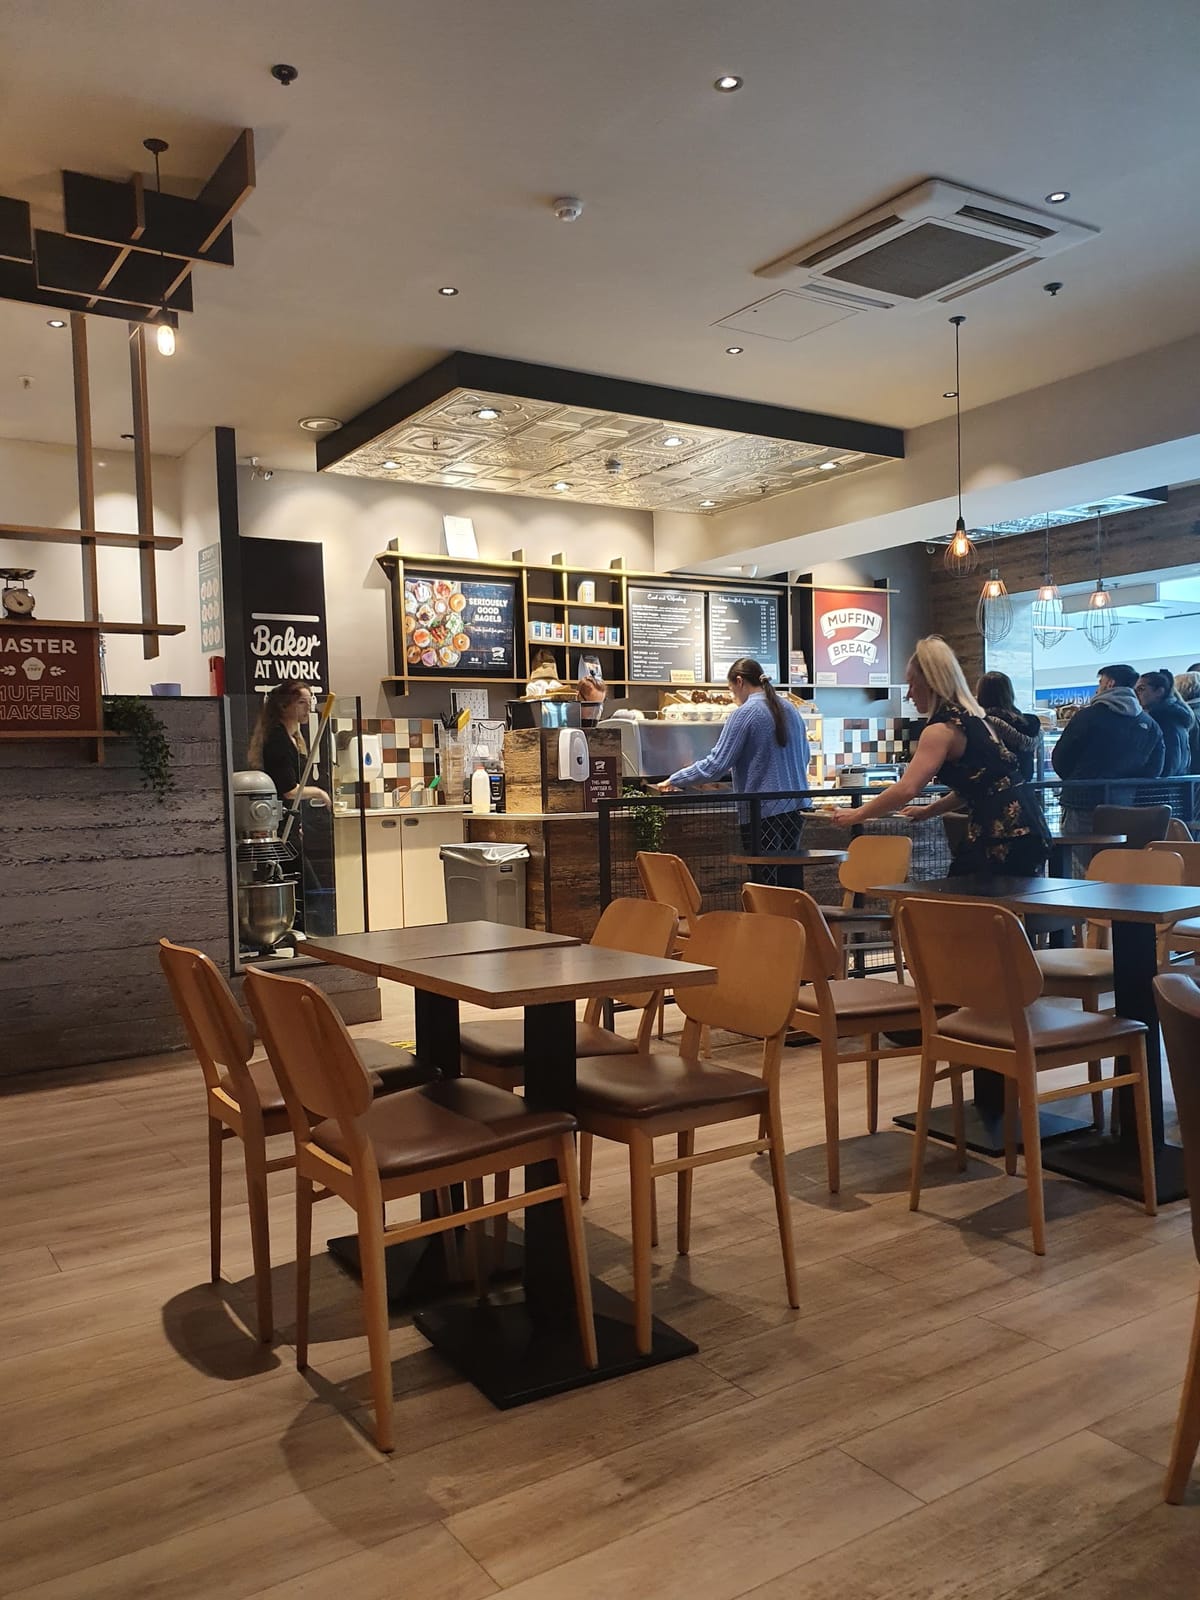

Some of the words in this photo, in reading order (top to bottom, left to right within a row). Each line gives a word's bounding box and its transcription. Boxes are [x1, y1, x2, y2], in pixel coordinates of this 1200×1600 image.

[468, 597, 509, 608] SERIOUSLY
[477, 606, 500, 615] GOOD
[474, 614, 502, 623] BAGELS
[827, 612, 876, 627] MUFFIN
[0, 638, 78, 655] ASTER
[250, 624, 321, 657] Baker
[832, 643, 872, 657] BREAK
[254, 659, 272, 679] AT
[274, 660, 321, 680] WORK
